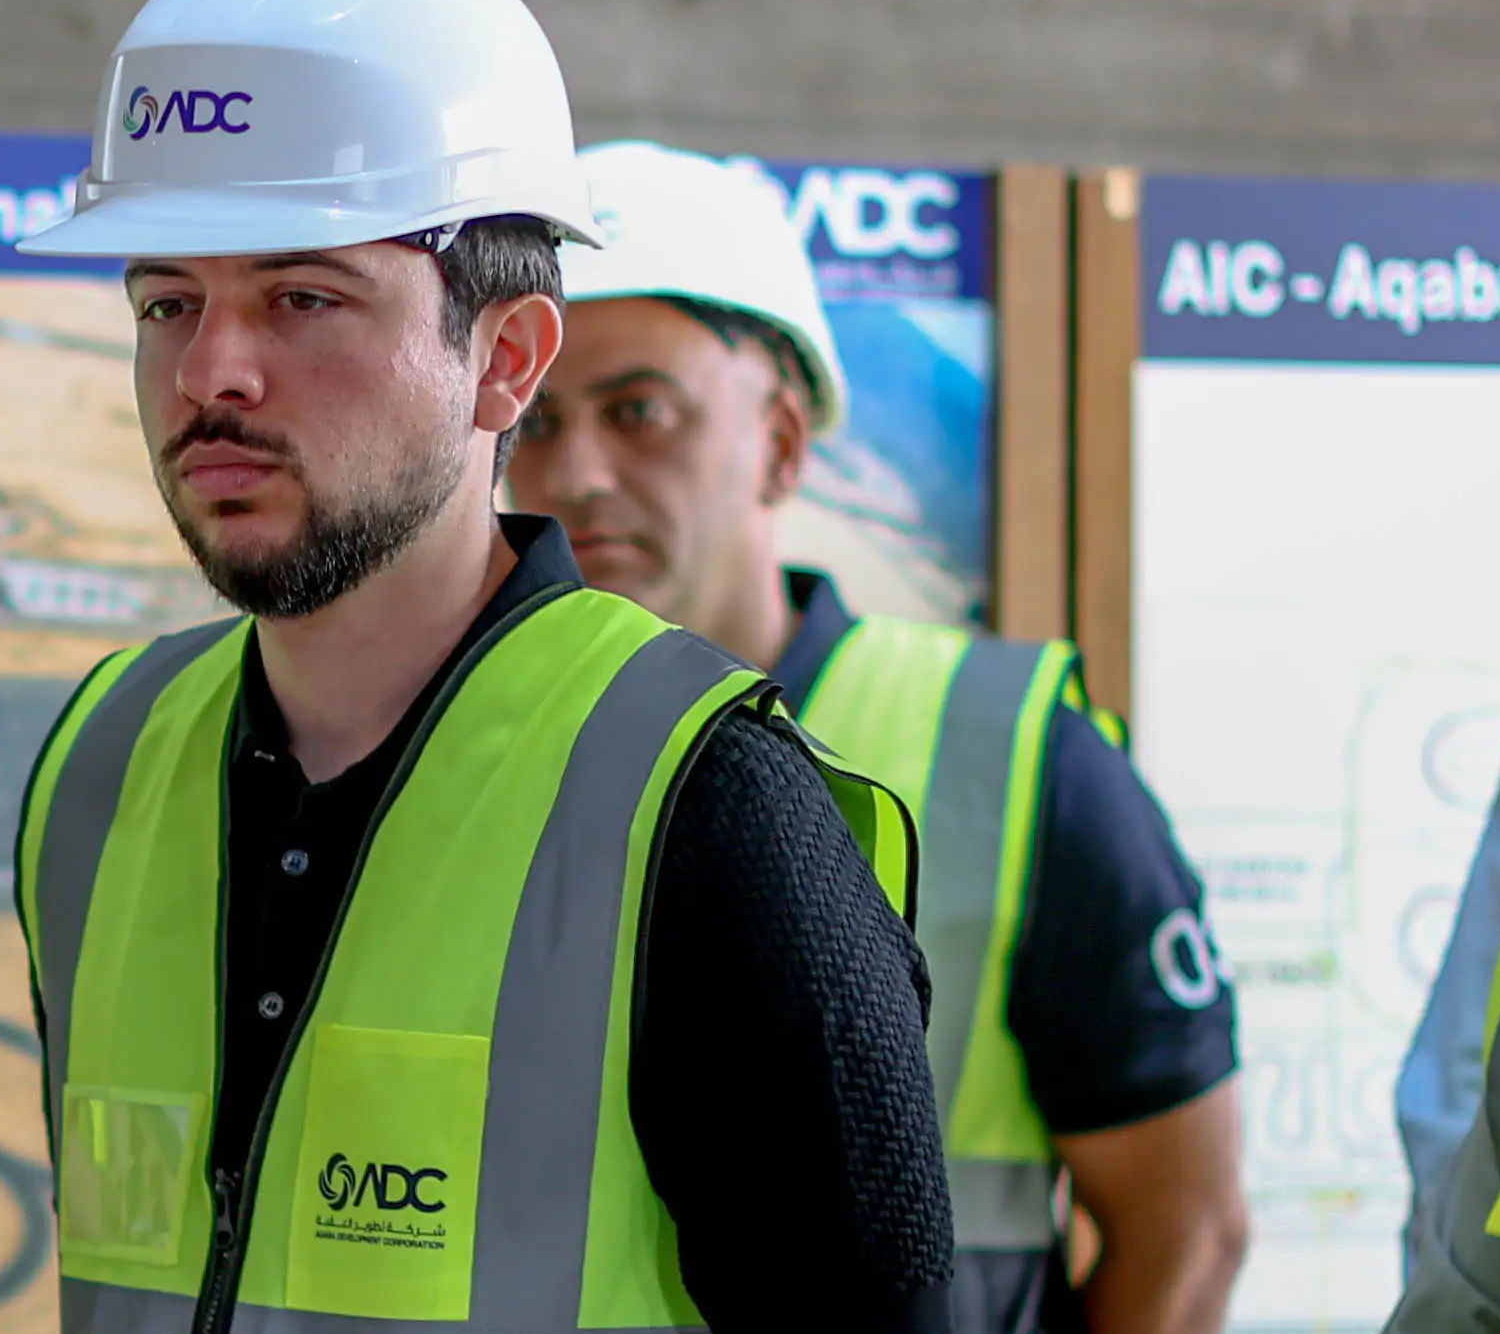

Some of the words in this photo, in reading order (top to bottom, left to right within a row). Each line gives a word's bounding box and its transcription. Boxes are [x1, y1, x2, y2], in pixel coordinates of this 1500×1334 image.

[155, 89, 253, 134] ADC
[1158, 238, 1285, 317] AIC
[352, 1162, 448, 1213] ADC
